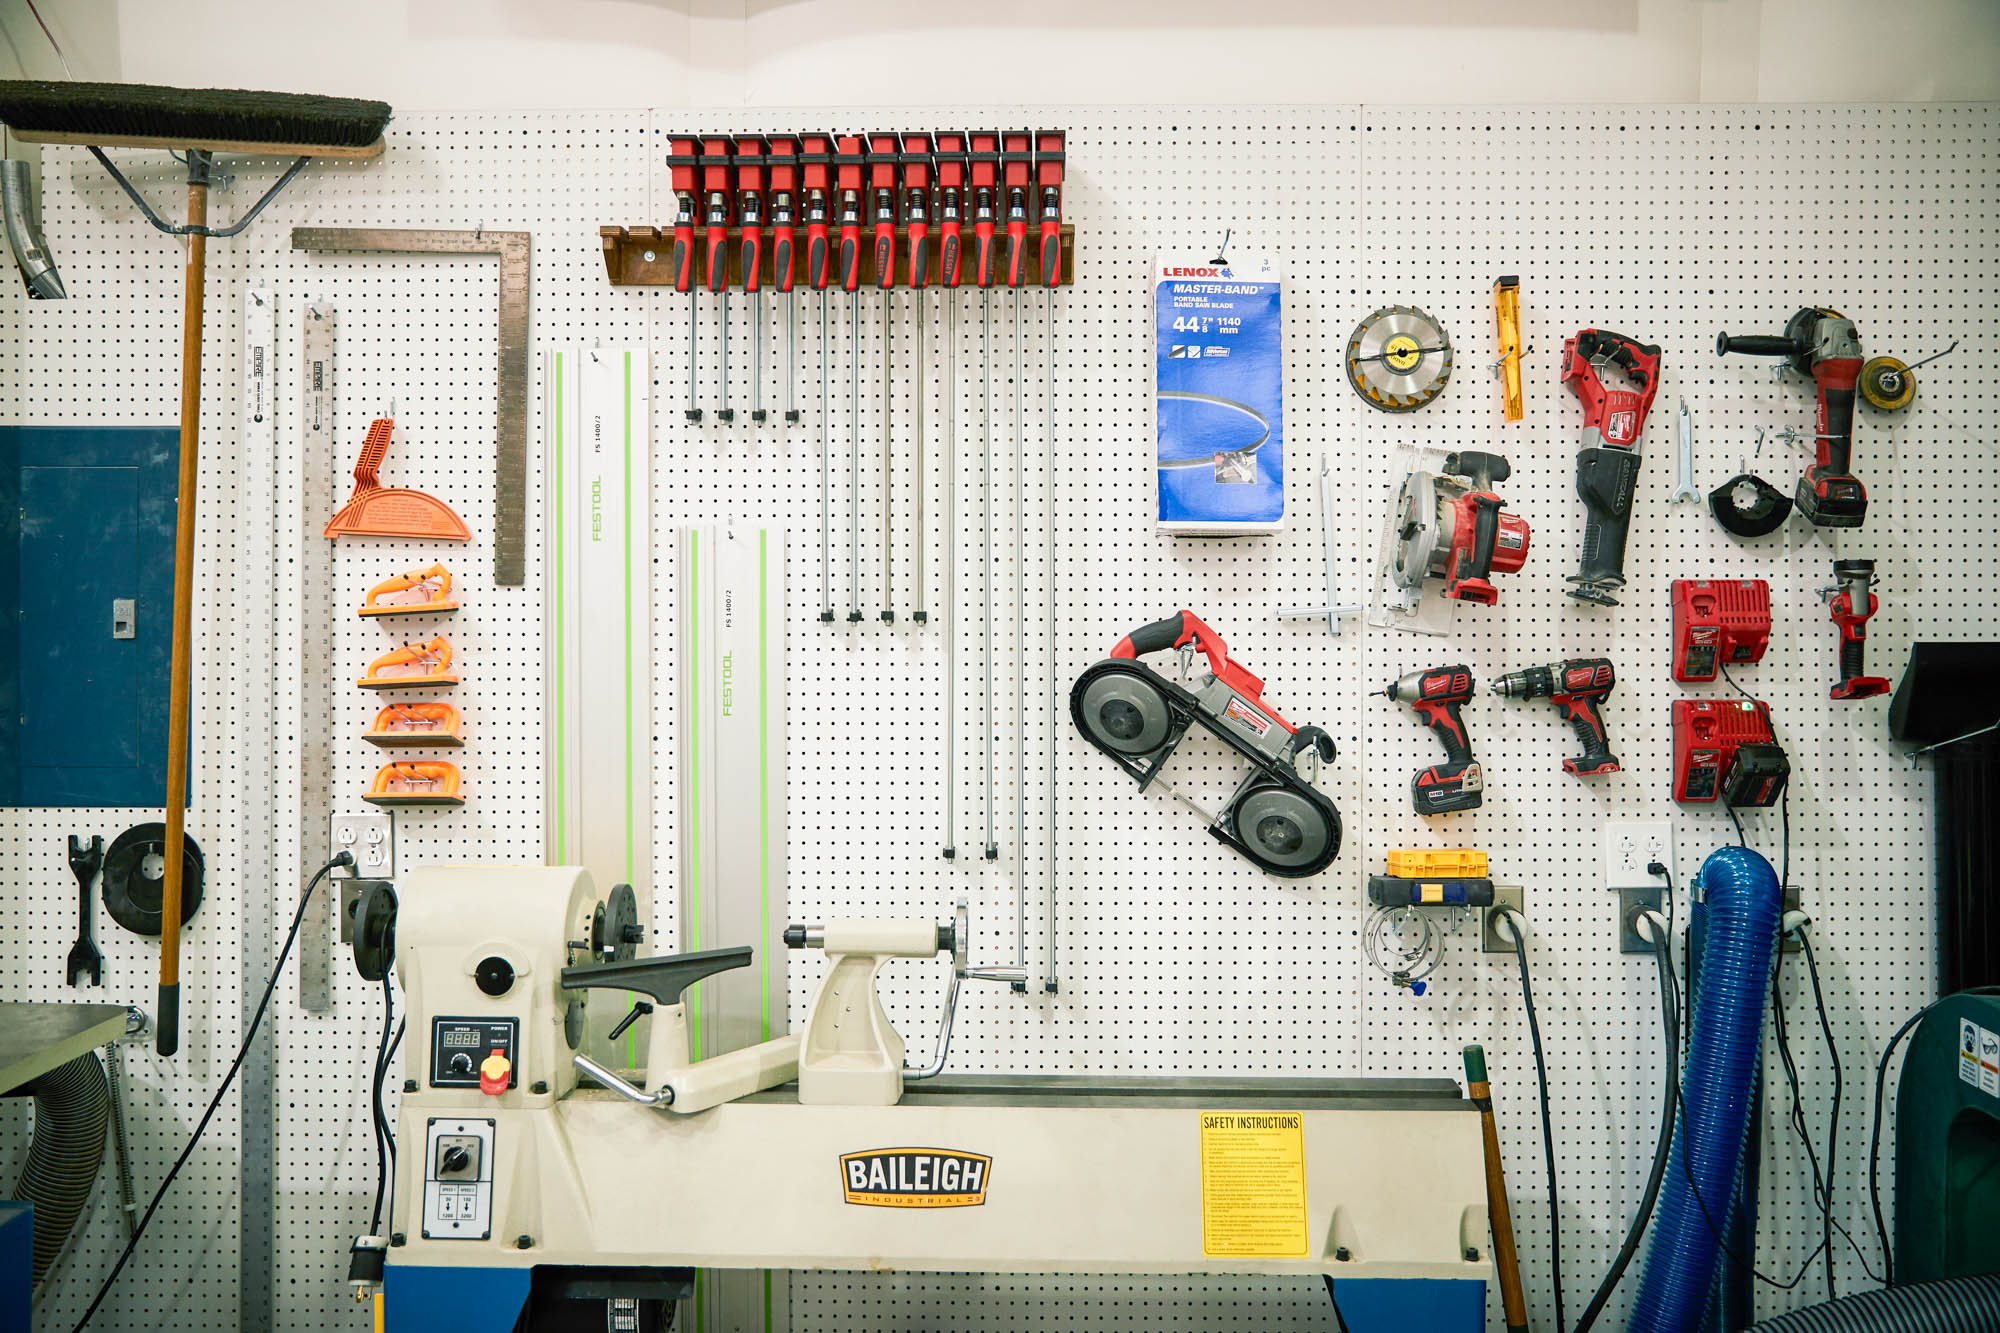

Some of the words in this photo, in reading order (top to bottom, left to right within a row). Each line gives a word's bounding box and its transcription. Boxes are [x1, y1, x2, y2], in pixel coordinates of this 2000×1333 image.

[1163, 267, 1219, 277] LENOX
[1173, 317, 1200, 332] 44
[1217, 317, 1241, 326] 1140
[1219, 326, 1239, 335] mm
[253, 346, 264, 377] EMPIRE
[313, 361, 323, 391] EMPIRE
[592, 474, 601, 542] FESTOOL
[725, 619, 732, 628] FS
[723, 648, 733, 717] FESTOOL
[1204, 1116, 1235, 1129] SAFETY
[1237, 1116, 1299, 1129] INSTRUCTIONS
[848, 1155, 983, 1192] BAILEIGH
[865, 1196, 962, 1204] INDUSTRIAL
